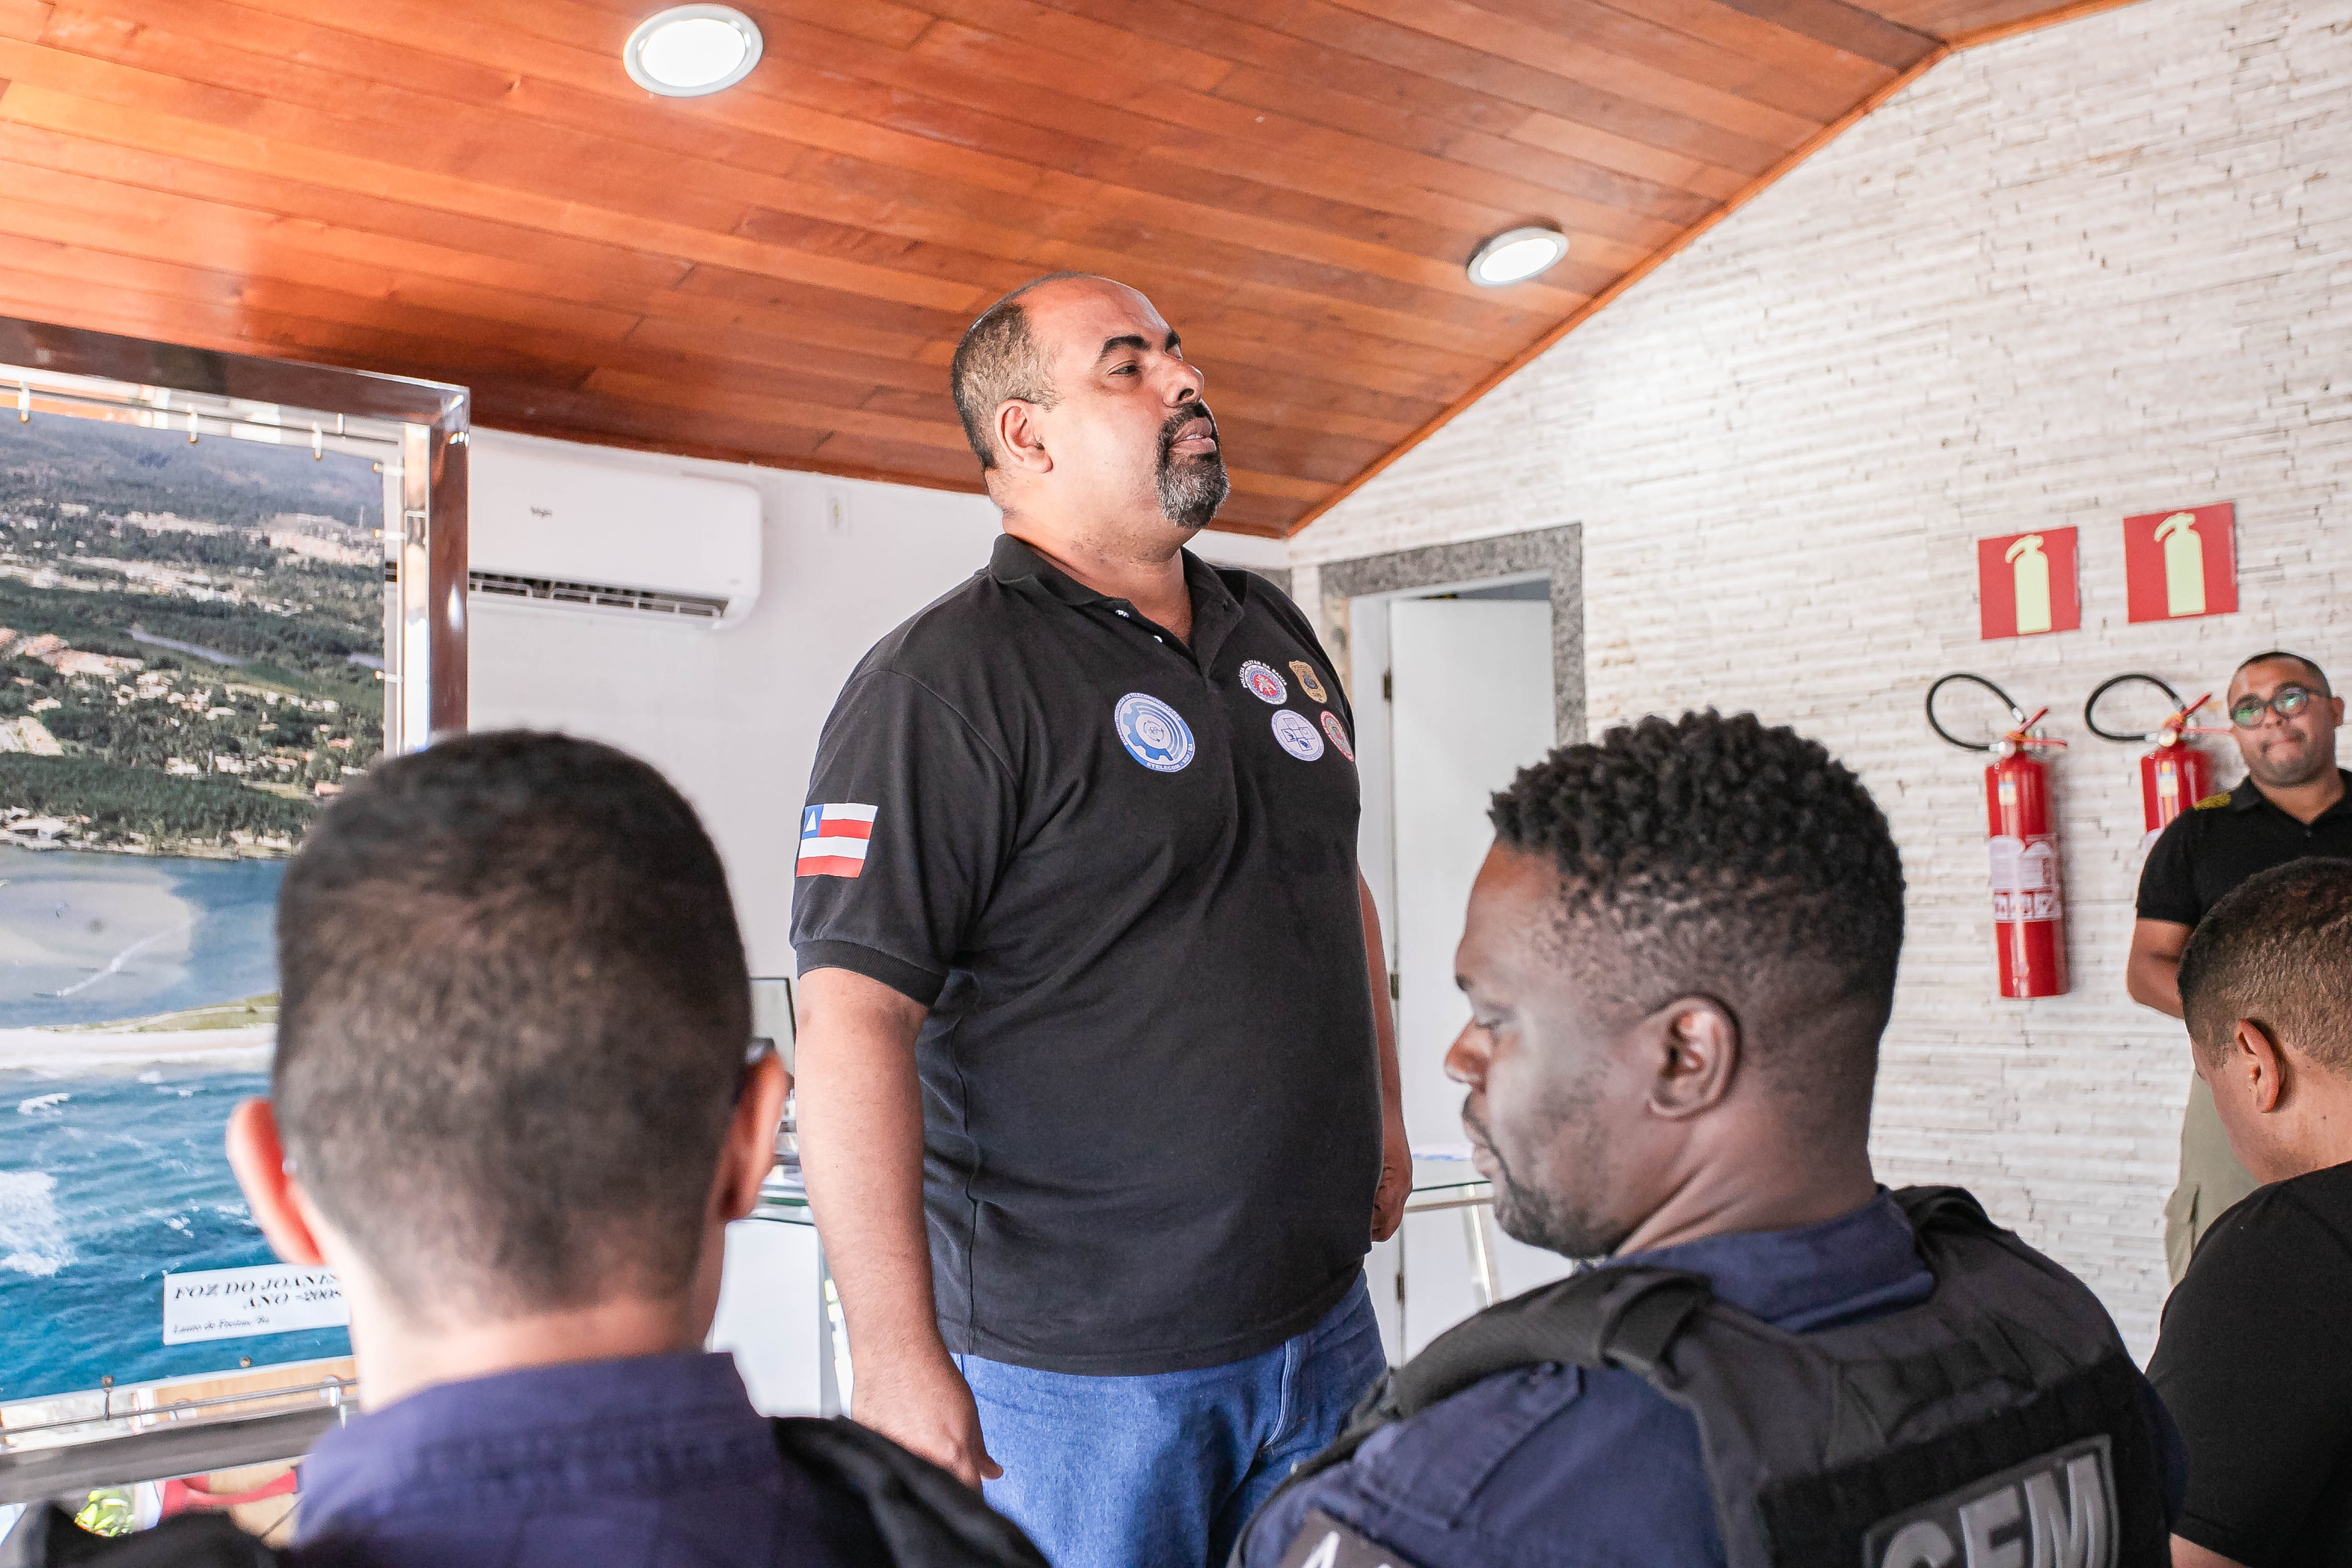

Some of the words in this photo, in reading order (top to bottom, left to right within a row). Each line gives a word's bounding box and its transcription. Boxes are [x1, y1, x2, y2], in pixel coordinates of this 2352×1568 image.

[1146, 762, 1181, 770] STELECOM
[173, 1283, 219, 1300] FOZ
[225, 1280, 255, 1295] DO
[244, 1292, 289, 1309] ANO
